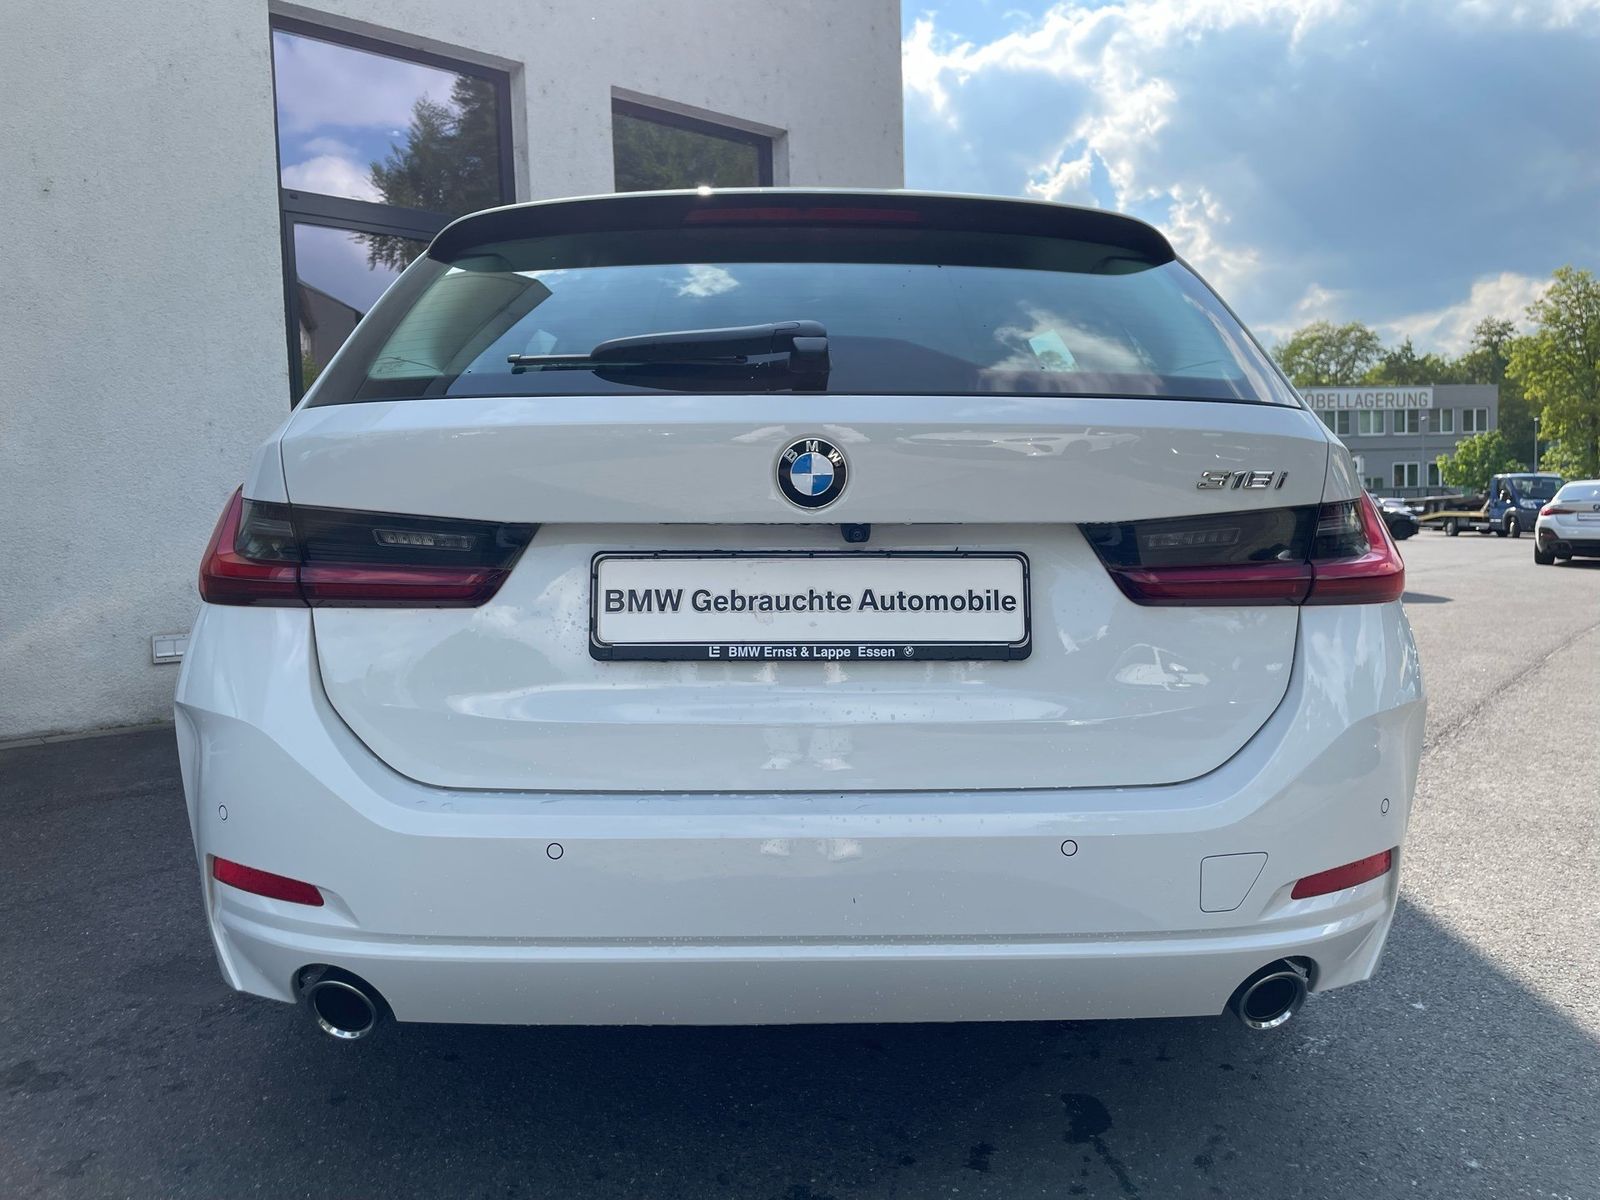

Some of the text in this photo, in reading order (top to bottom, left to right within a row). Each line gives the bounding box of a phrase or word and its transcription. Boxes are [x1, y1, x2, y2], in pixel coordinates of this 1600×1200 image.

[1300, 390, 1428, 409] ÖBELLAGERUNG
[784, 440, 843, 467] BMW
[1197, 470, 1289, 489] 318i
[605, 589, 1017, 612] BMW Gebrauchte Automobile
[728, 646, 760, 657] BMW
[764, 646, 797, 657] Ernst
[800, 646, 809, 657] &
[813, 646, 851, 660] Lappe
[857, 646, 896, 657] Essen
